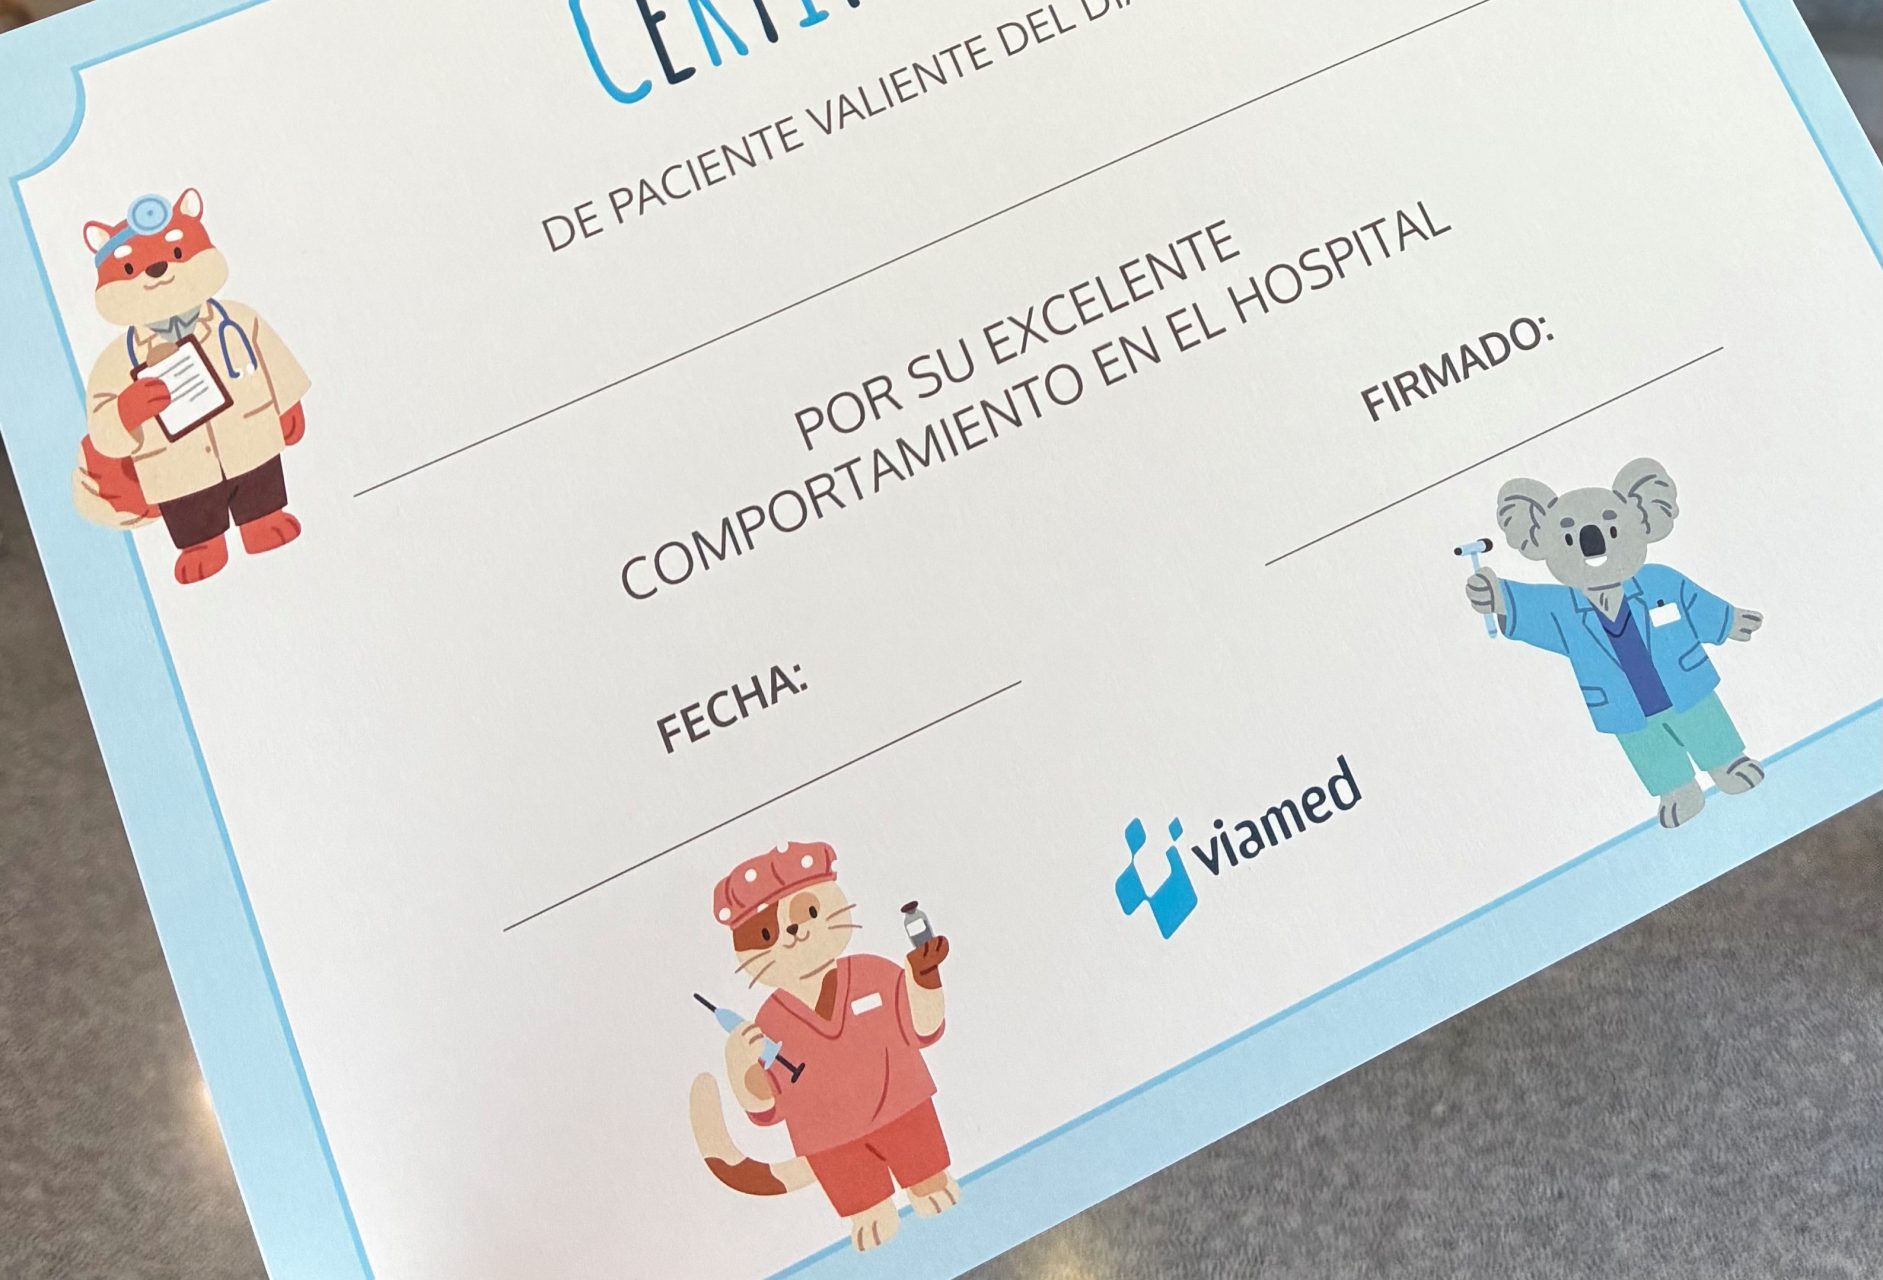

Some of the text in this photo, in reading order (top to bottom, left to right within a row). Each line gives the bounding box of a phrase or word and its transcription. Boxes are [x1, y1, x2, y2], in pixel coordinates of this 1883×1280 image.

[541, 200, 604, 253] DE
[608, 115, 805, 225] PACIENTE
[805, 21, 994, 136] VALIENTE
[996, 3, 1077, 57] DEL
[621, 200, 1453, 600] COMPORTAMIENTO EN EL HOSPITAL
[794, 219, 1241, 452] POR SU EXCELENTE
[1360, 316, 1555, 423] FIRMADO:
[656, 663, 809, 755] FECHA:
[1191, 753, 1363, 877] viamed
